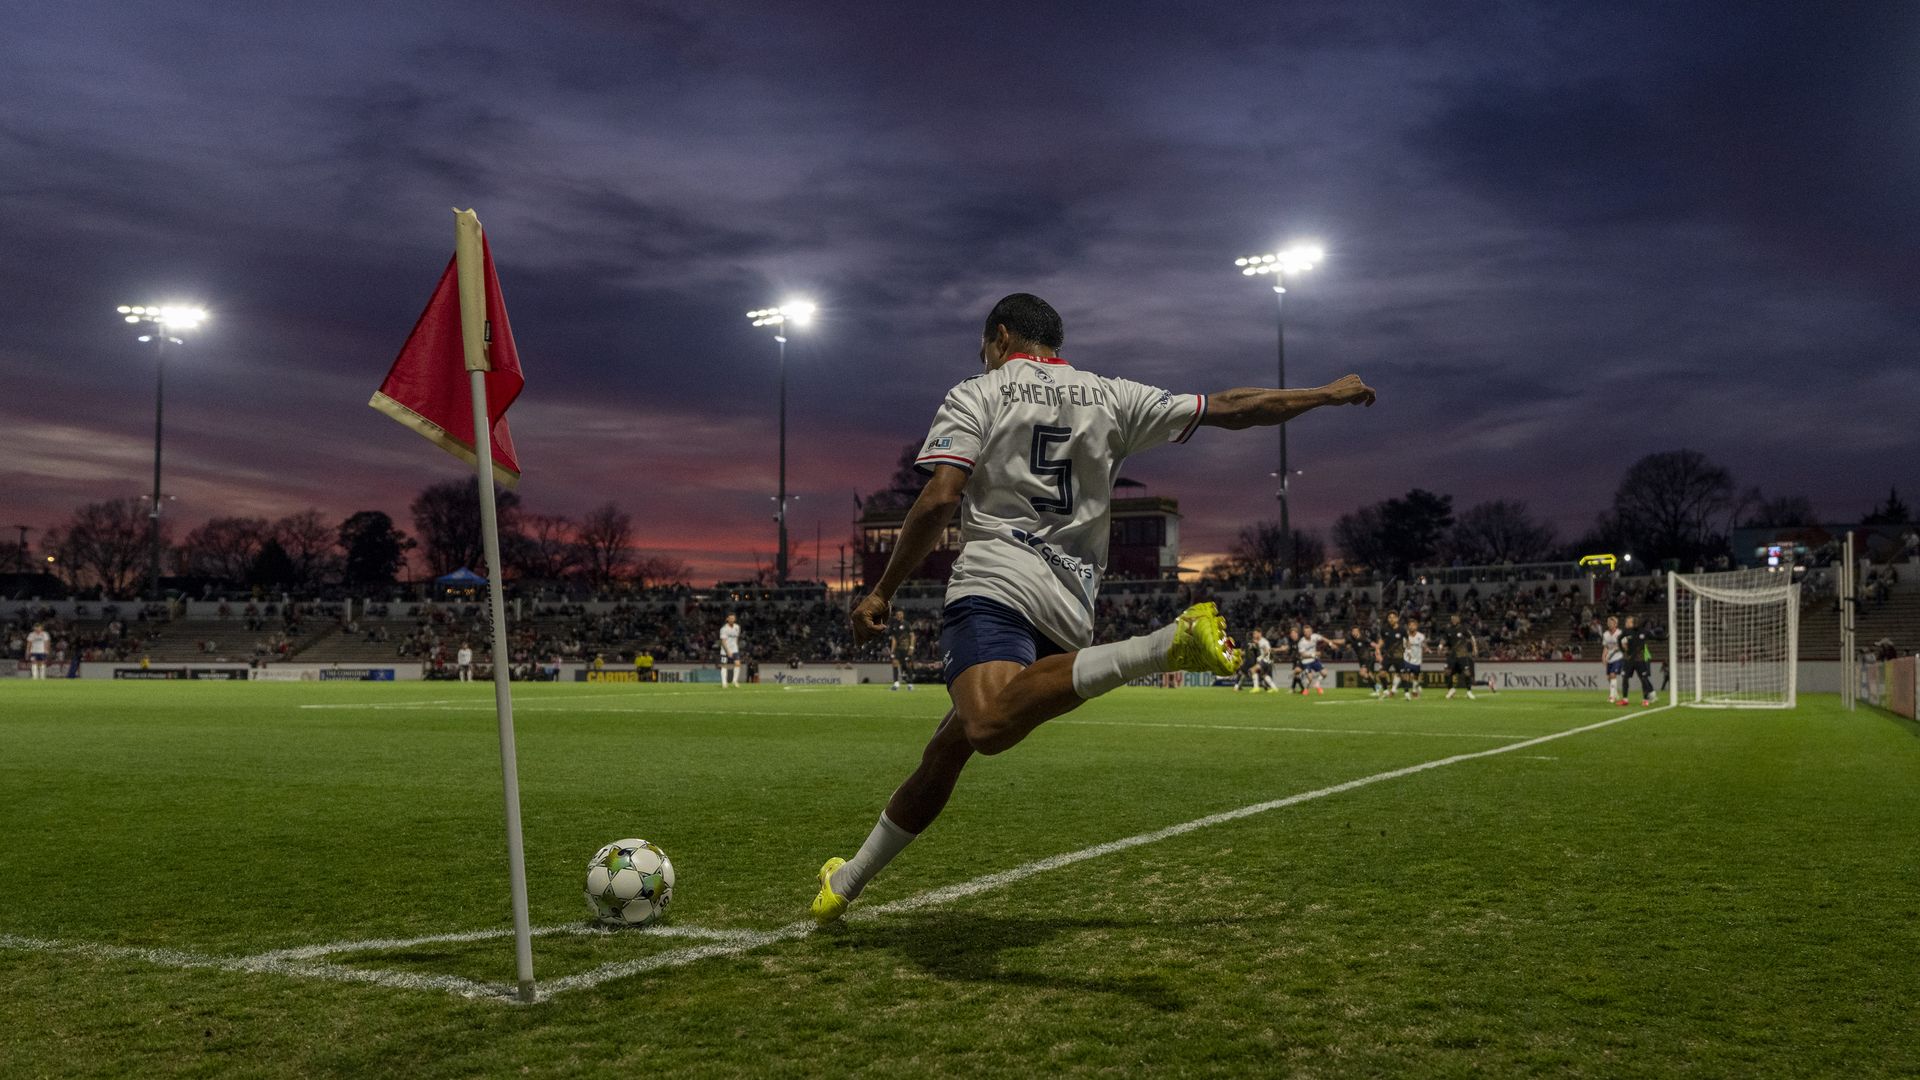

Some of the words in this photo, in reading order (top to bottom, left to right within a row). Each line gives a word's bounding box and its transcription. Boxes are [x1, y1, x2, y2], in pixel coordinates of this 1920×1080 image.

[1030, 424, 1073, 515] 5
[1041, 545, 1094, 580] Secors
[786, 675, 804, 684] Bon
[806, 675, 842, 684] Secours
[1427, 672, 1458, 683] TITE
